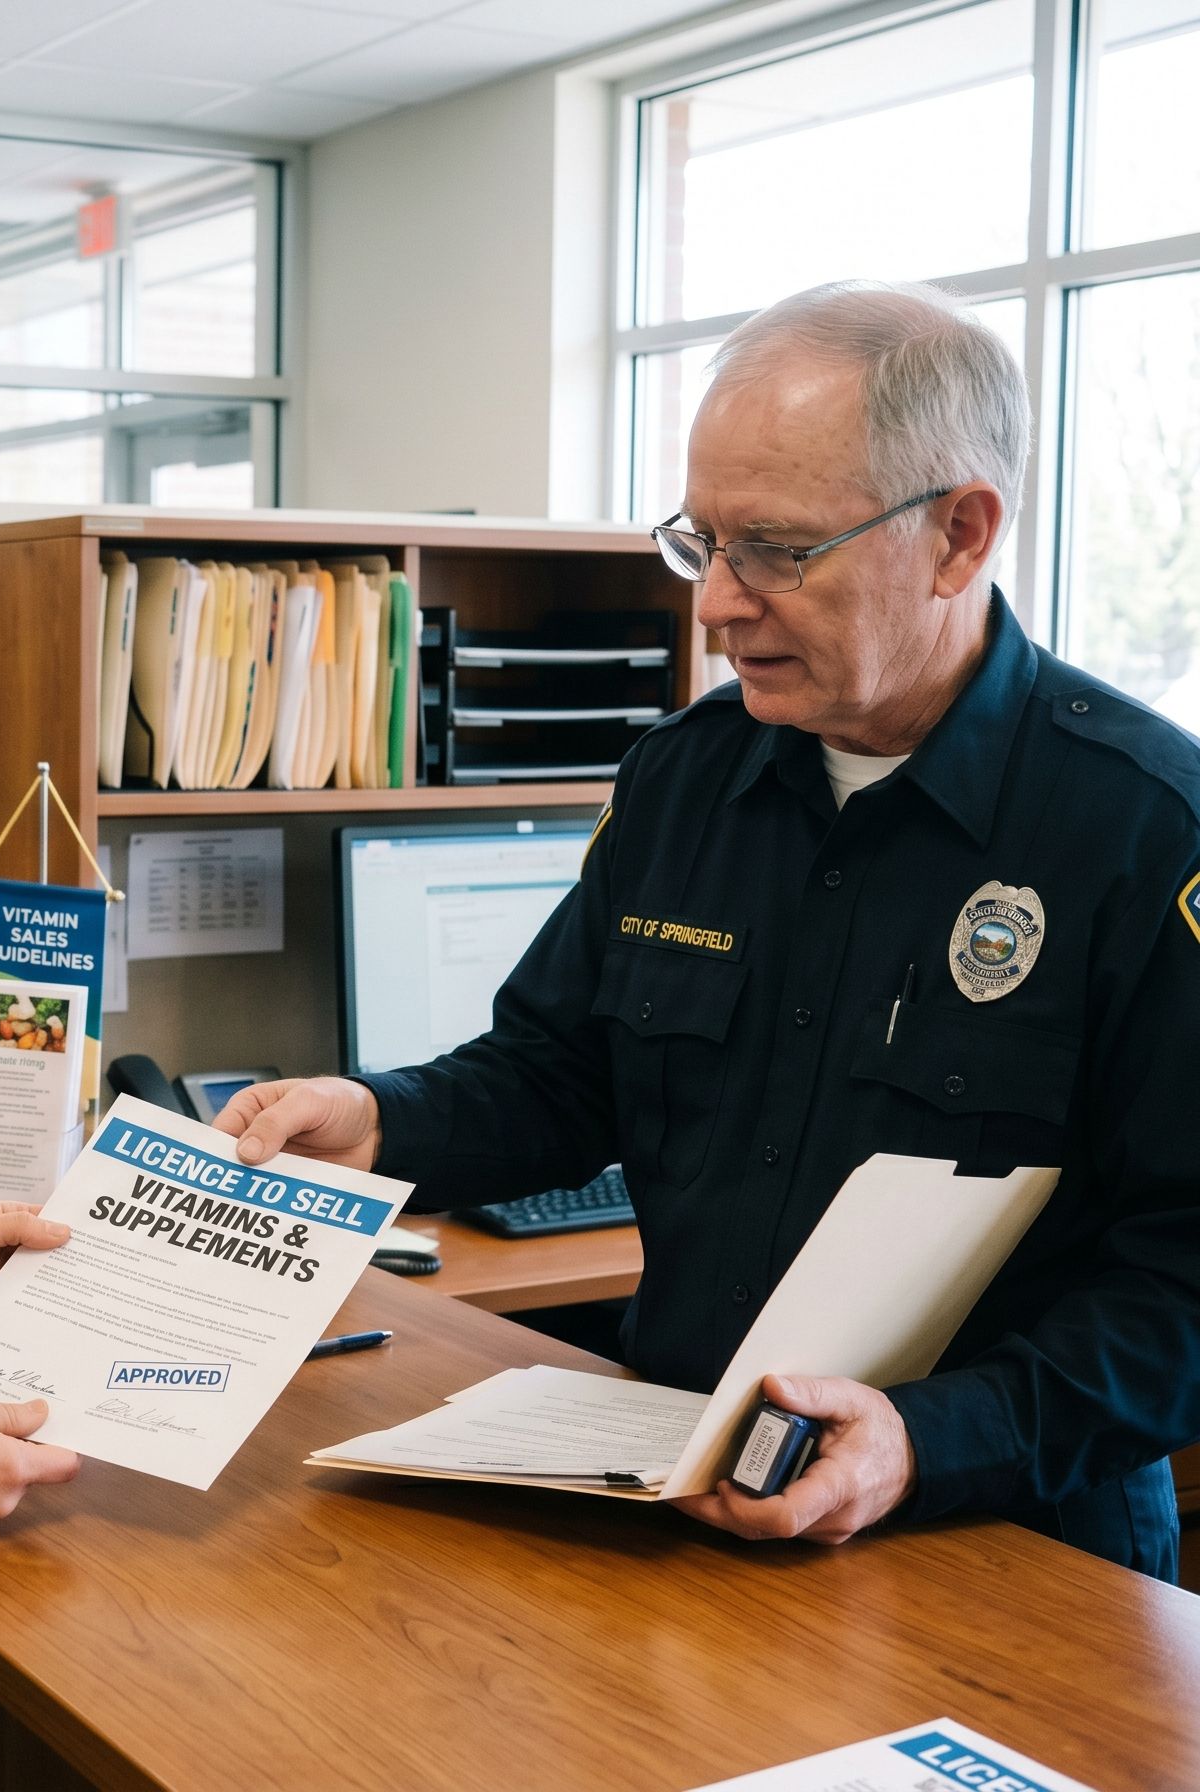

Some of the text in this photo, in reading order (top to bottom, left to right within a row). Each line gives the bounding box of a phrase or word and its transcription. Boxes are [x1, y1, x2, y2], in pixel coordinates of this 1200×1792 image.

[2, 906, 79, 930] VITAMIN
[10, 927, 68, 948] SALES
[621, 916, 733, 951] CITY OF SPRINGFIELD
[114, 1129, 363, 1227] LICENCE TO SELL
[130, 1174, 309, 1249] VITAMINS &
[89, 1195, 320, 1283] SUPPLEMENTS
[114, 1367, 222, 1386] APPROVED
[917, 1744, 1039, 1792] LICE
